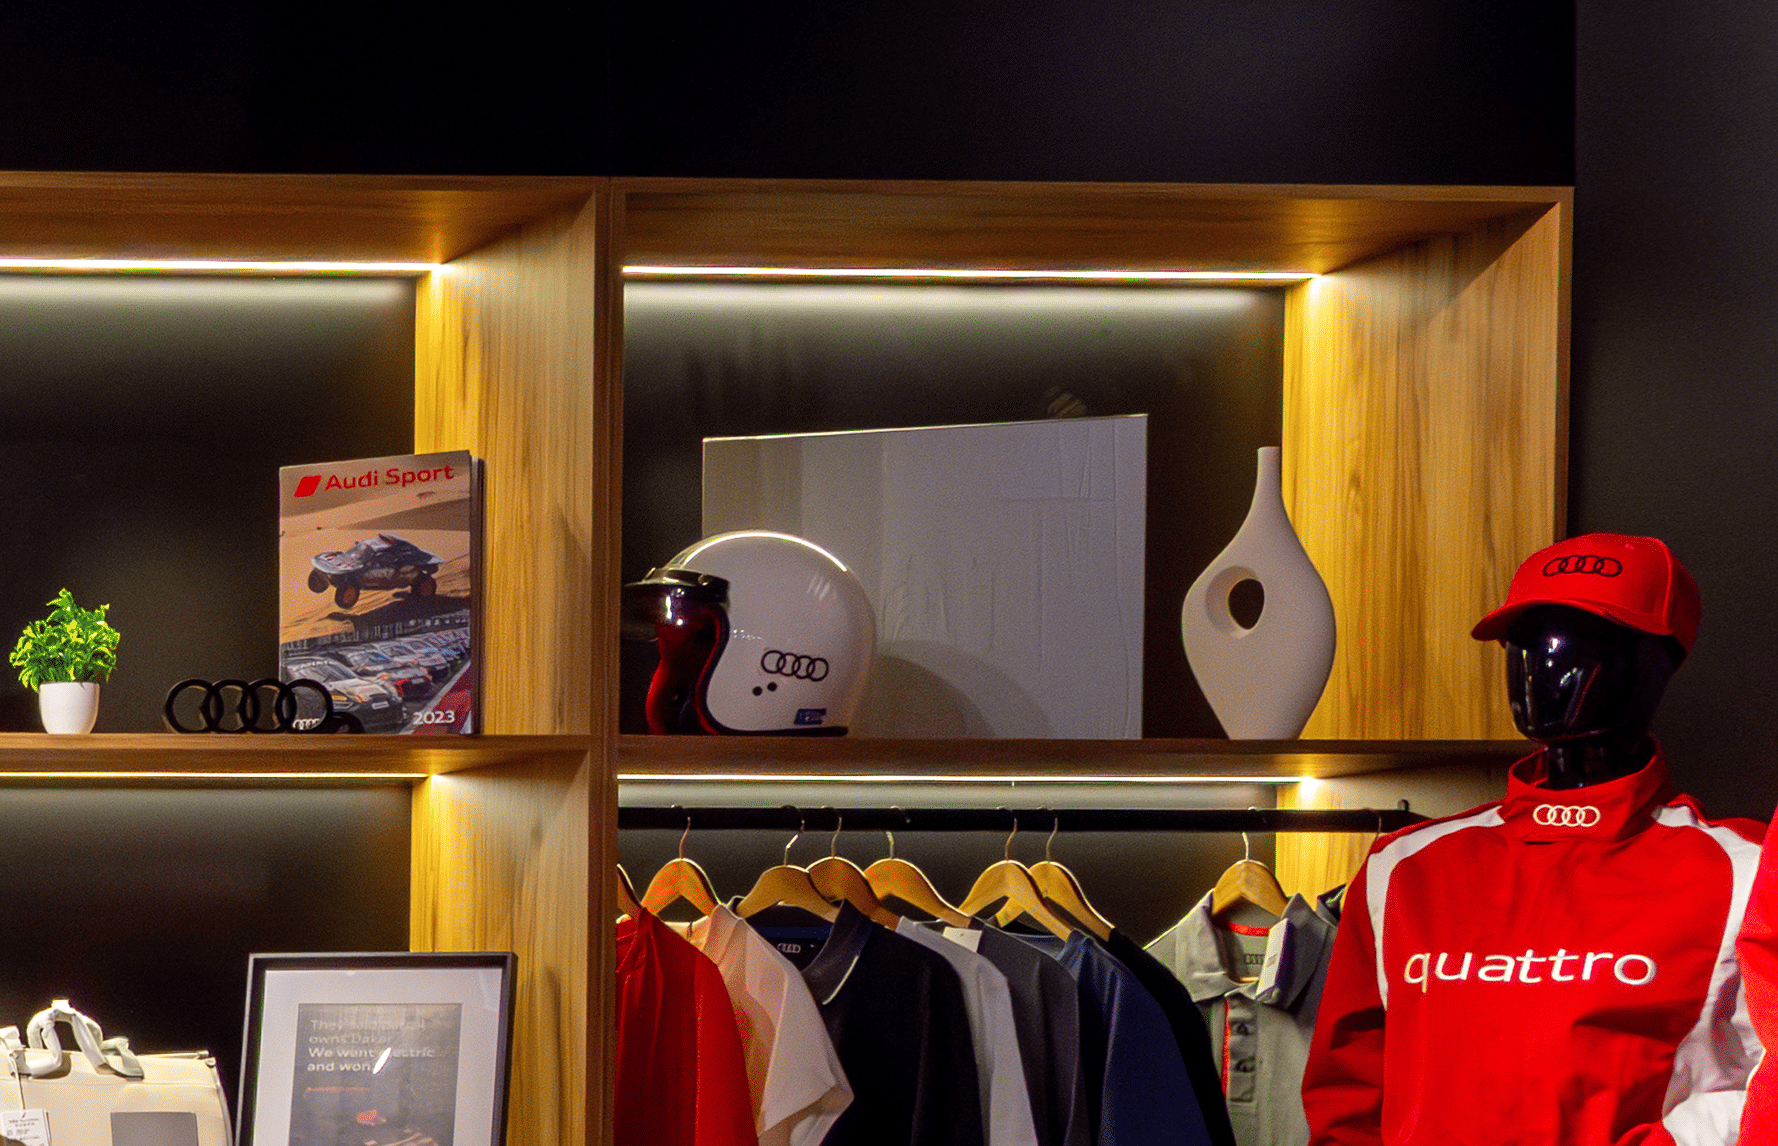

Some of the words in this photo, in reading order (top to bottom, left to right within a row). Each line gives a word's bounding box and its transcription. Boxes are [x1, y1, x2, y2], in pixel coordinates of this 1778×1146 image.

[324, 470, 380, 491] Audi
[385, 465, 455, 488] Sport
[412, 710, 456, 725] 2023
[1404, 948, 1658, 994] quattro
[308, 1047, 334, 1058] We
[337, 1048, 376, 1058] went
[307, 1062, 335, 1072] and
